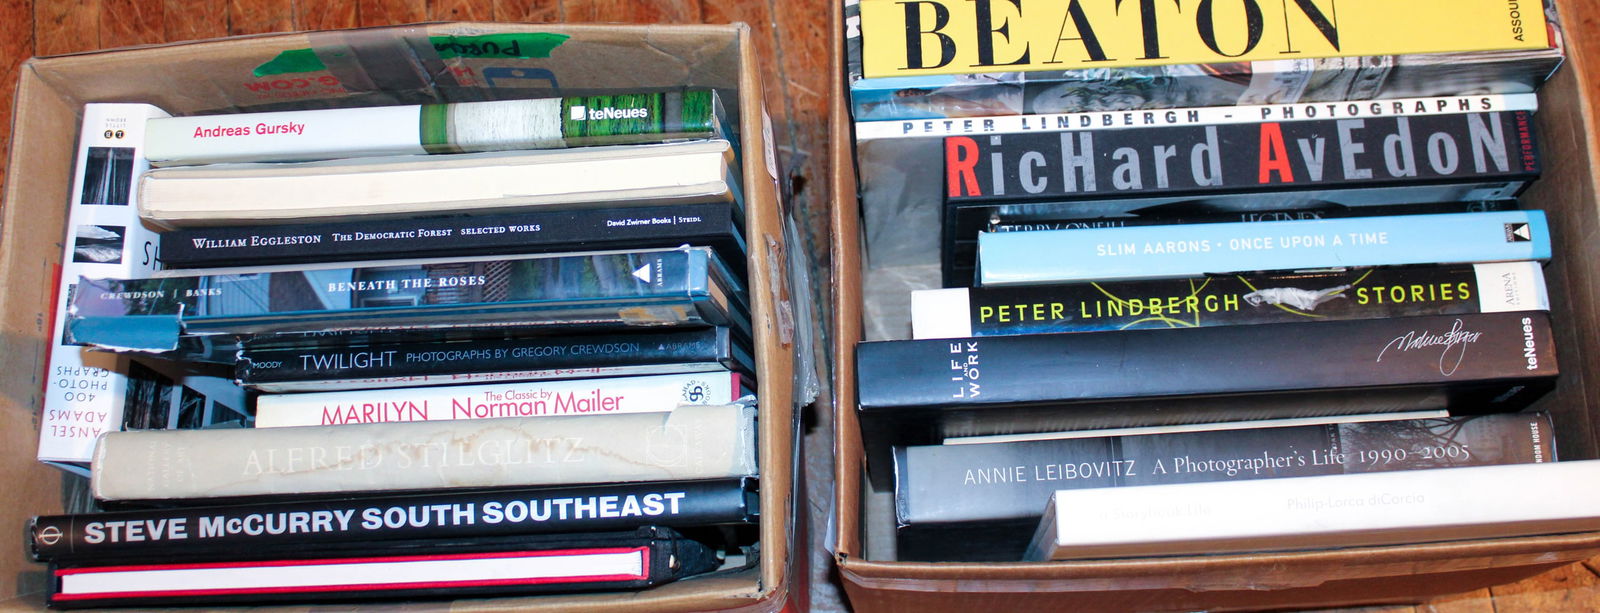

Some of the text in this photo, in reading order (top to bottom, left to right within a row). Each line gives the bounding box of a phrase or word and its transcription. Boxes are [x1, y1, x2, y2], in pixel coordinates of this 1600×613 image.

[1508, 0, 1524, 42] ASSOU
[897, 0, 1341, 70] BEATON
[588, 105, 648, 120] teNeues
[902, 117, 994, 135] PETER
[1021, 110, 1200, 131] LINDBERGH
[1261, 97, 1493, 120] PHOTOGRAPHS
[193, 121, 305, 138] Andreas Gursky
[1516, 111, 1536, 171] PERFORMANCE
[332, 223, 541, 242] THE DEMOCRATIC FOREST SELECTED WORKS
[606, 215, 702, 227] David Zwirner Books STEIDL
[192, 234, 321, 249] WILLIAM EGGLESTON
[1096, 232, 1389, 257] SLIM AARONS ONCE UPON A TIME
[100, 287, 223, 300] CREWDSON BANKS
[328, 274, 486, 293] BENEATH THE ROSES
[1502, 272, 1515, 305] ARENA
[980, 282, 1471, 323] PETER LINDBERGH STORIES
[665, 342, 701, 351] ABRAMS
[1522, 317, 1538, 370] teNeues
[252, 342, 640, 371] MOODY TWILIGHT PHOTOGRAPHS BY GREGORY CREWDSON
[56, 366, 110, 378] GRAPHS
[950, 342, 964, 399] LIFE
[967, 342, 980, 398] WORK
[53, 378, 108, 390] PHOTO-
[484, 388, 553, 402] The Classic by
[64, 392, 96, 402] 400
[452, 390, 625, 420] Norman Mailer
[48, 409, 108, 422] ADAMS
[320, 400, 428, 424] MARILYN
[50, 425, 101, 439] ANSEL
[1530, 422, 1544, 463] NDOM HOUSE
[242, 446, 384, 475] ALFRED
[964, 466, 1027, 486] ANNIE
[1035, 460, 1136, 482] LEIBOVITZ
[1152, 459, 1167, 475] A
[1174, 450, 1306, 478] Photographer's
[1311, 446, 1345, 466] Life
[1287, 492, 1425, 513] Philip-Lorca diCorcia
[84, 492, 686, 545] STEVE McCURRY SOUTH SOUTHEAST
